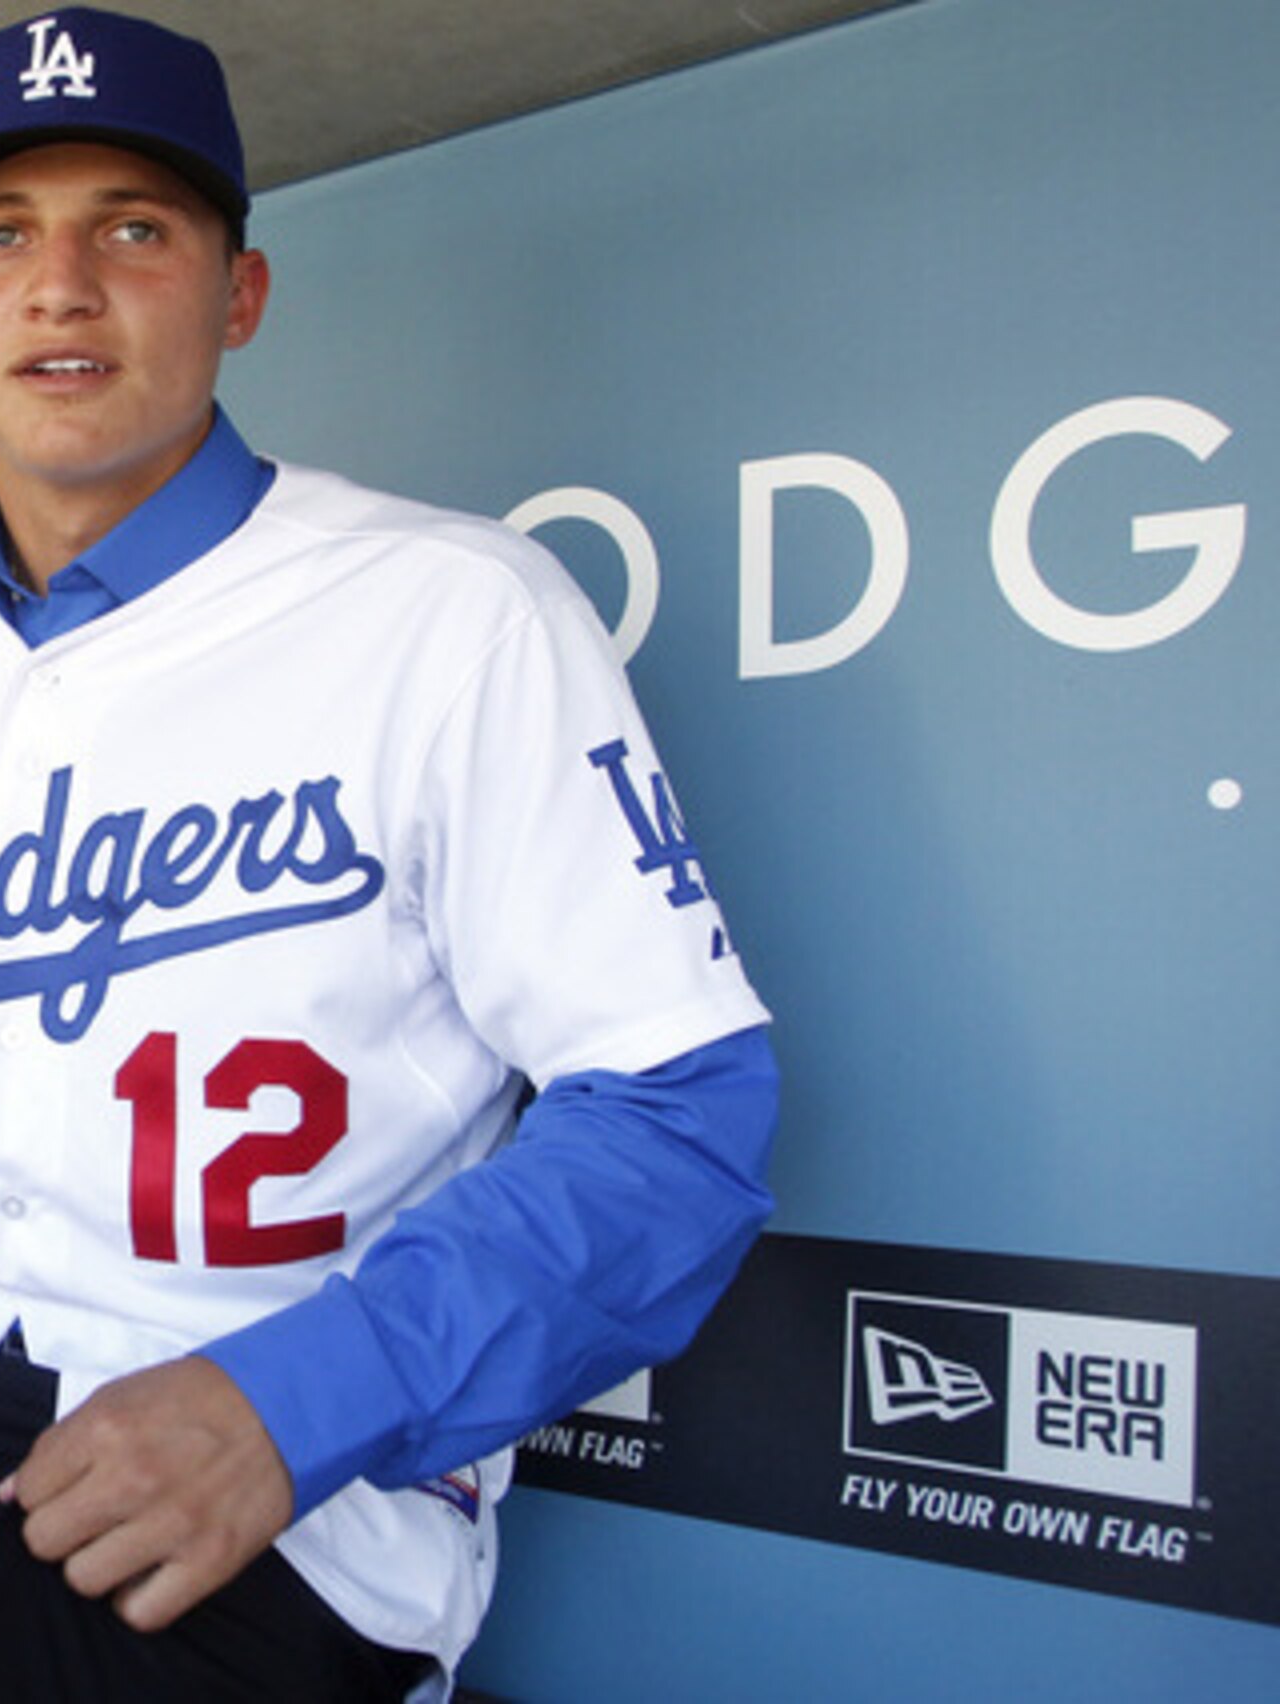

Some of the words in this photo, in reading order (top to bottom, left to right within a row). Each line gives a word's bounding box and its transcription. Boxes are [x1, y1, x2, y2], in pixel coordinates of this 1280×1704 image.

[19, 17, 97, 101] LA
[114, 1030, 349, 1268] 12
[1036, 1350, 1166, 1409] NEW
[578, 1431, 645, 1470] FLAG
[1035, 1399, 1165, 1461] ERA
[840, 1474, 899, 1511] FLY
[905, 1482, 994, 1529] YOUR
[1002, 1503, 1090, 1546] OWN
[1096, 1519, 1190, 1563] FLAG
